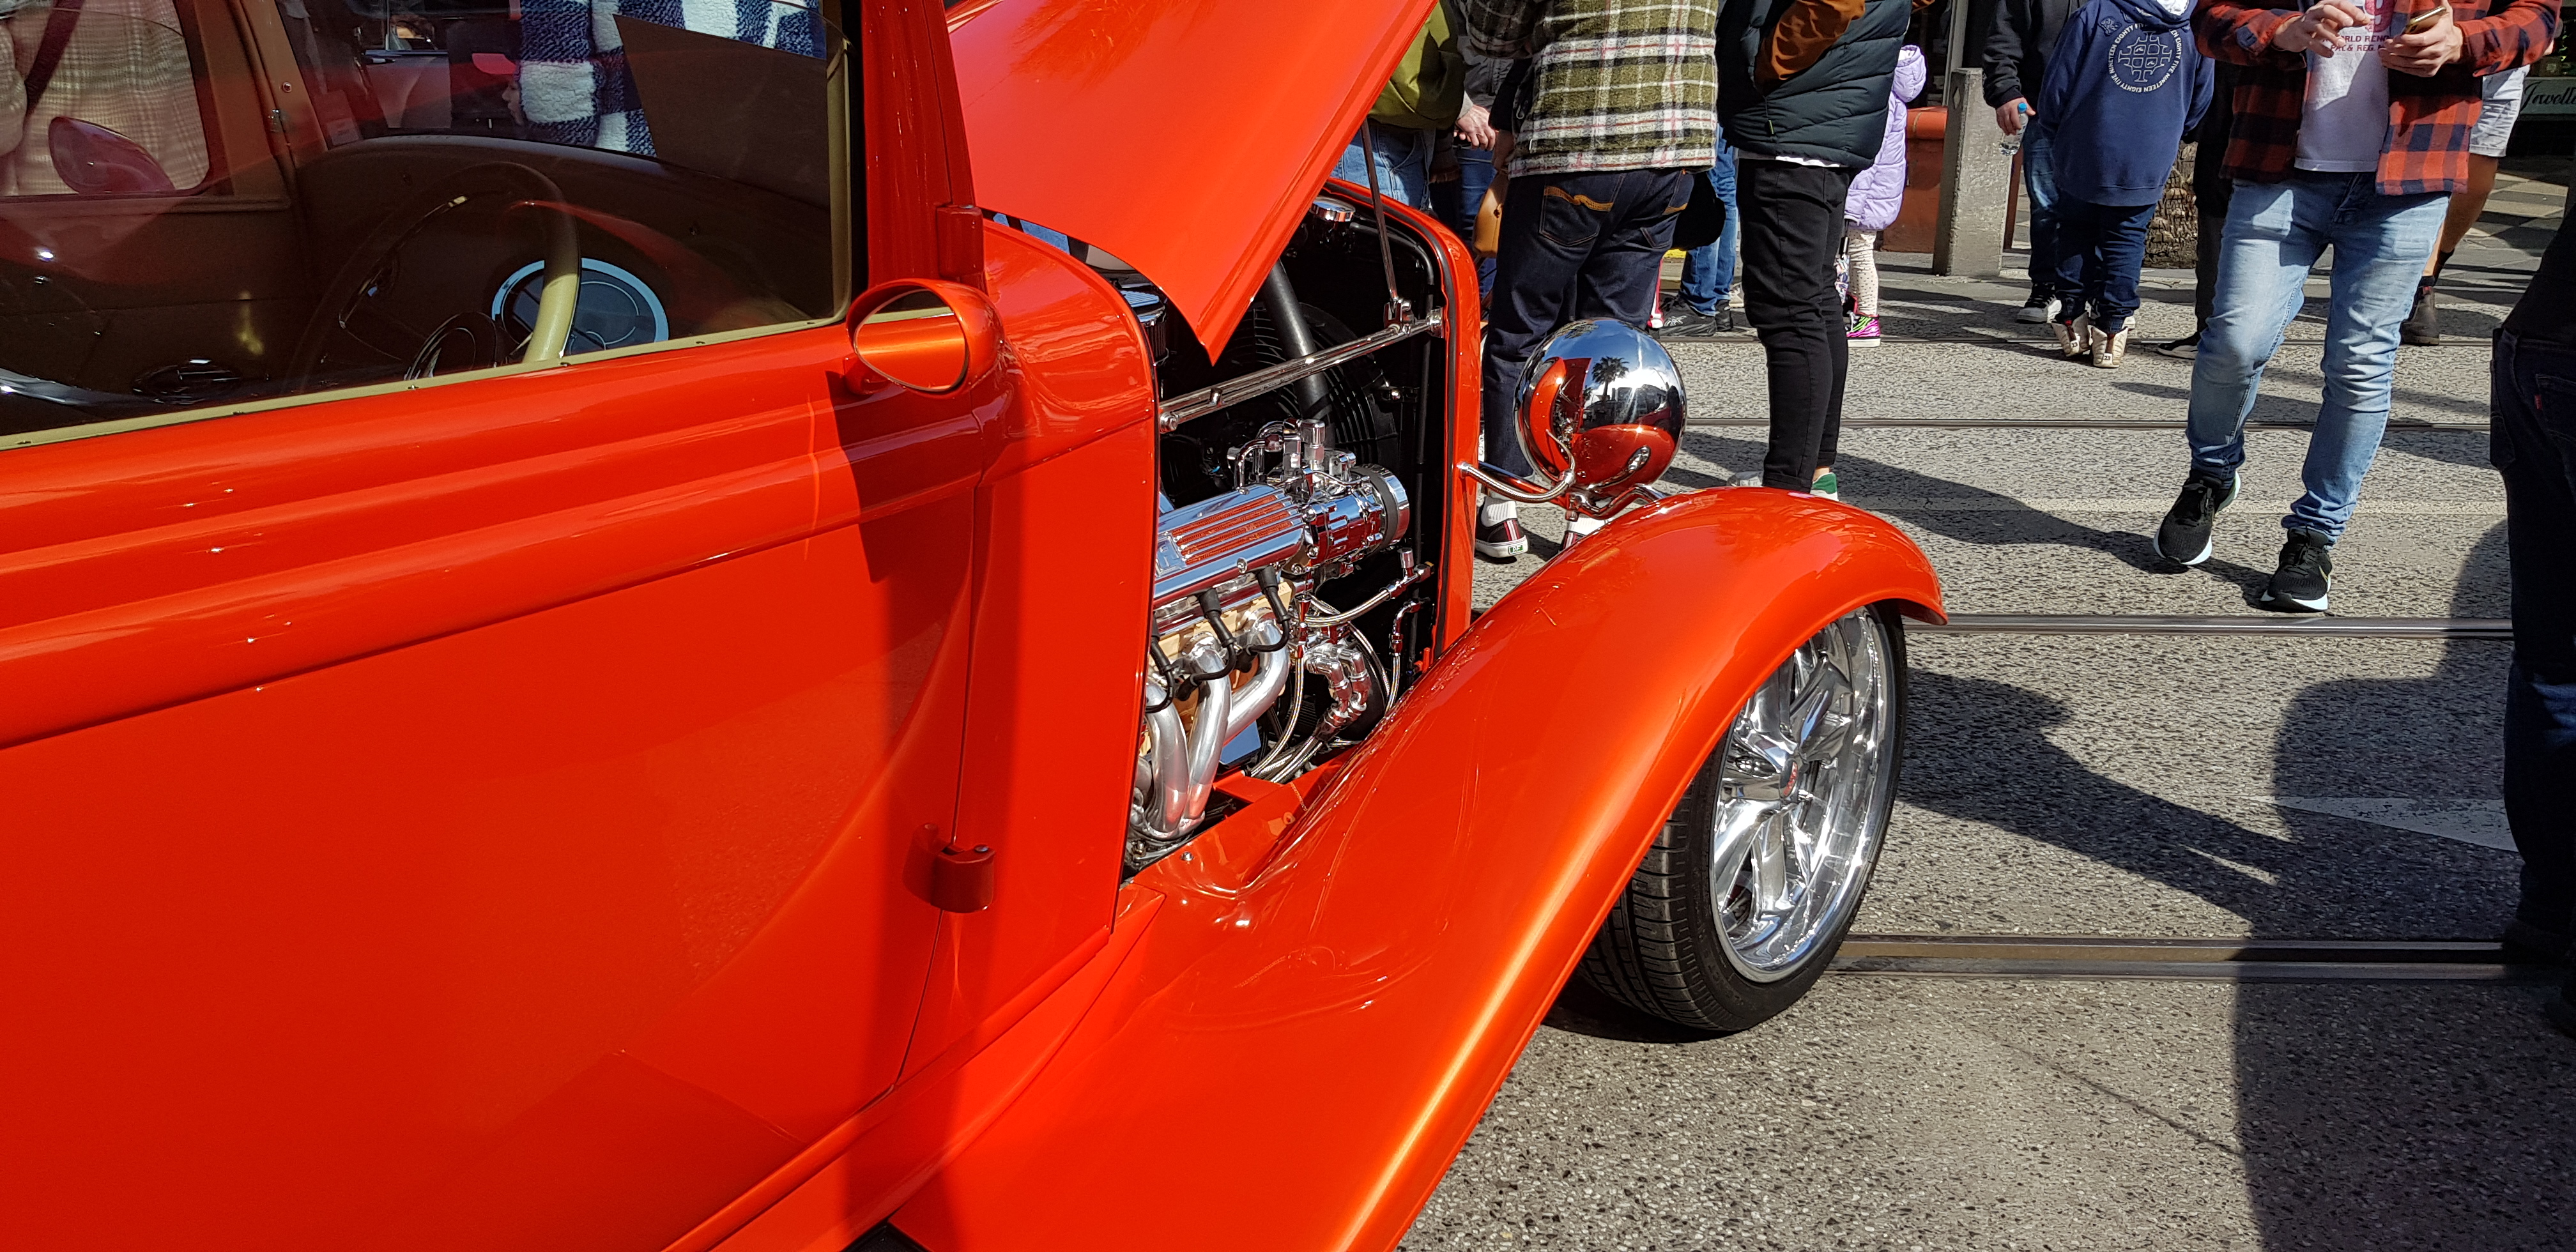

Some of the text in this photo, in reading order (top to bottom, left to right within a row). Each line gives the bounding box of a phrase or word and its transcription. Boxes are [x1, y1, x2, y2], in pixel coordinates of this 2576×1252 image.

[2108, 44, 2117, 74] NINETEEN
[2115, 24, 2134, 44] EIGHTY
[2168, 60, 2179, 73] FIVE
[2111, 72, 2170, 93] NINETEEN EIGHTY FIVE
